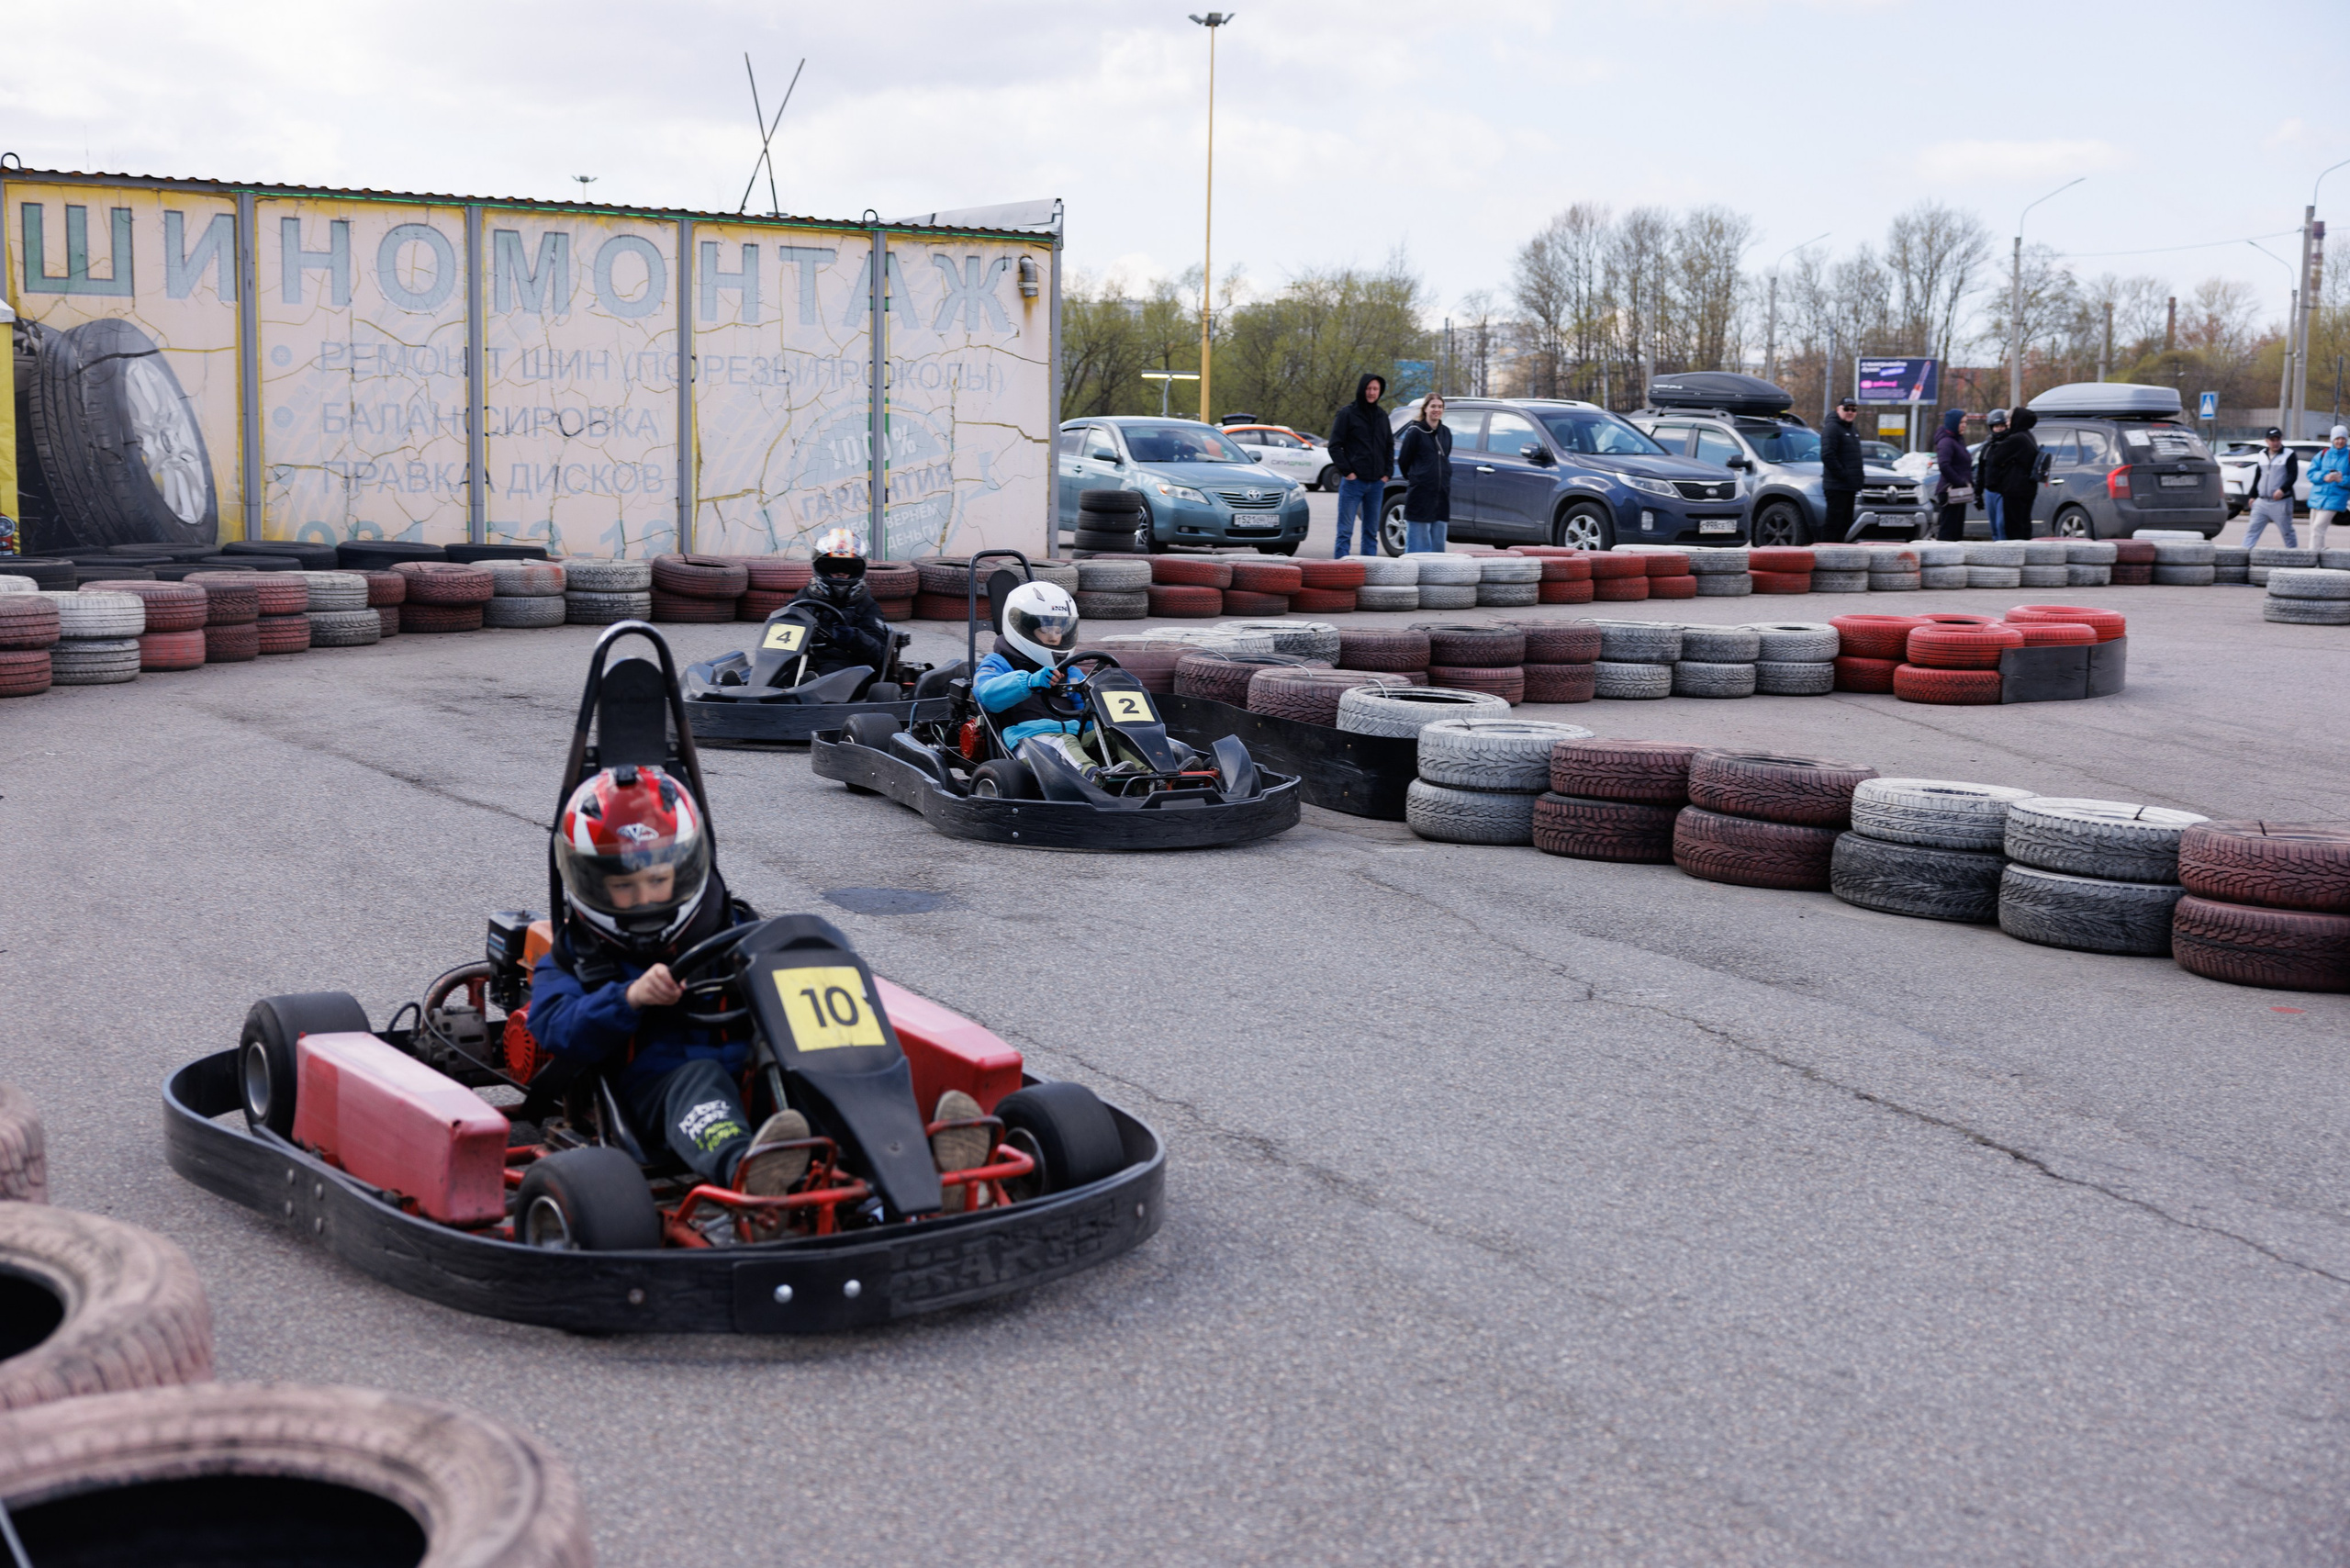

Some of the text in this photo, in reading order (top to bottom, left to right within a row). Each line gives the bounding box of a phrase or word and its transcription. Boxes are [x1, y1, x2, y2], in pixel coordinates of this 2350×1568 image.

[21, 202, 1012, 333] ШИНОМОНТАЖ
[321, 342, 509, 378] РЕМОНТ
[521, 348, 610, 381] ШИН
[322, 402, 659, 439] БАЛАНСИРОВКА
[827, 425, 917, 470] 100%
[323, 461, 664, 500] ПРАВКА ДИСКОВ
[800, 462, 954, 521] ГАРАНТИЯ
[885, 503, 938, 530] ВЕРНЕМ
[887, 523, 939, 551] ДЕНЬГИ
[776, 631, 792, 644] 4
[1118, 698, 1140, 714] 2
[800, 986, 859, 1028] 10
